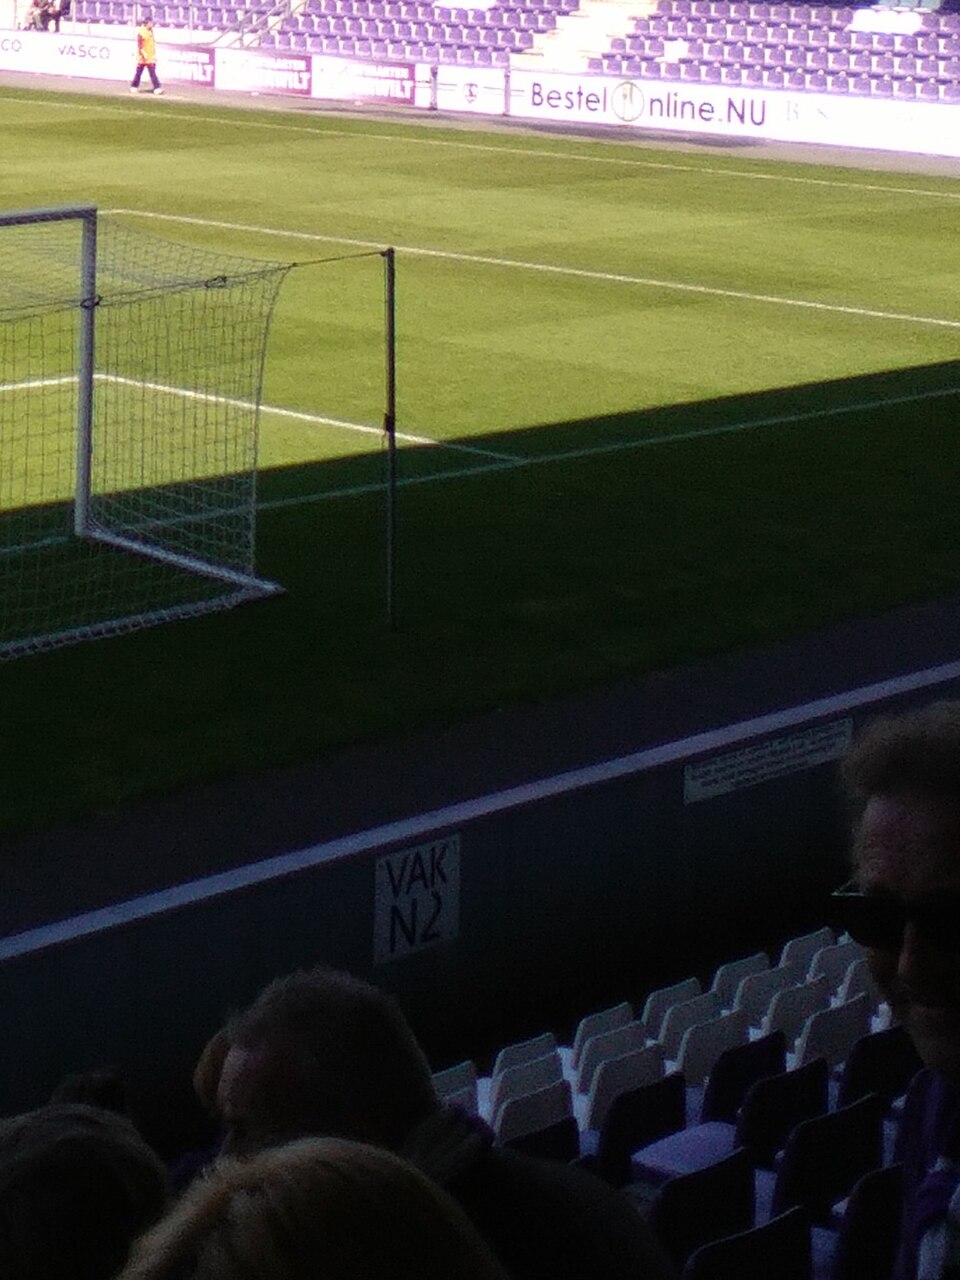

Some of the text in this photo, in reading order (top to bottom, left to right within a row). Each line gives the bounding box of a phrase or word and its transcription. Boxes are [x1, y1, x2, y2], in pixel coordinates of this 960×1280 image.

[58, 44, 110, 60] VASCO
[385, 843, 449, 898] VAK
[389, 890, 443, 953] N2
